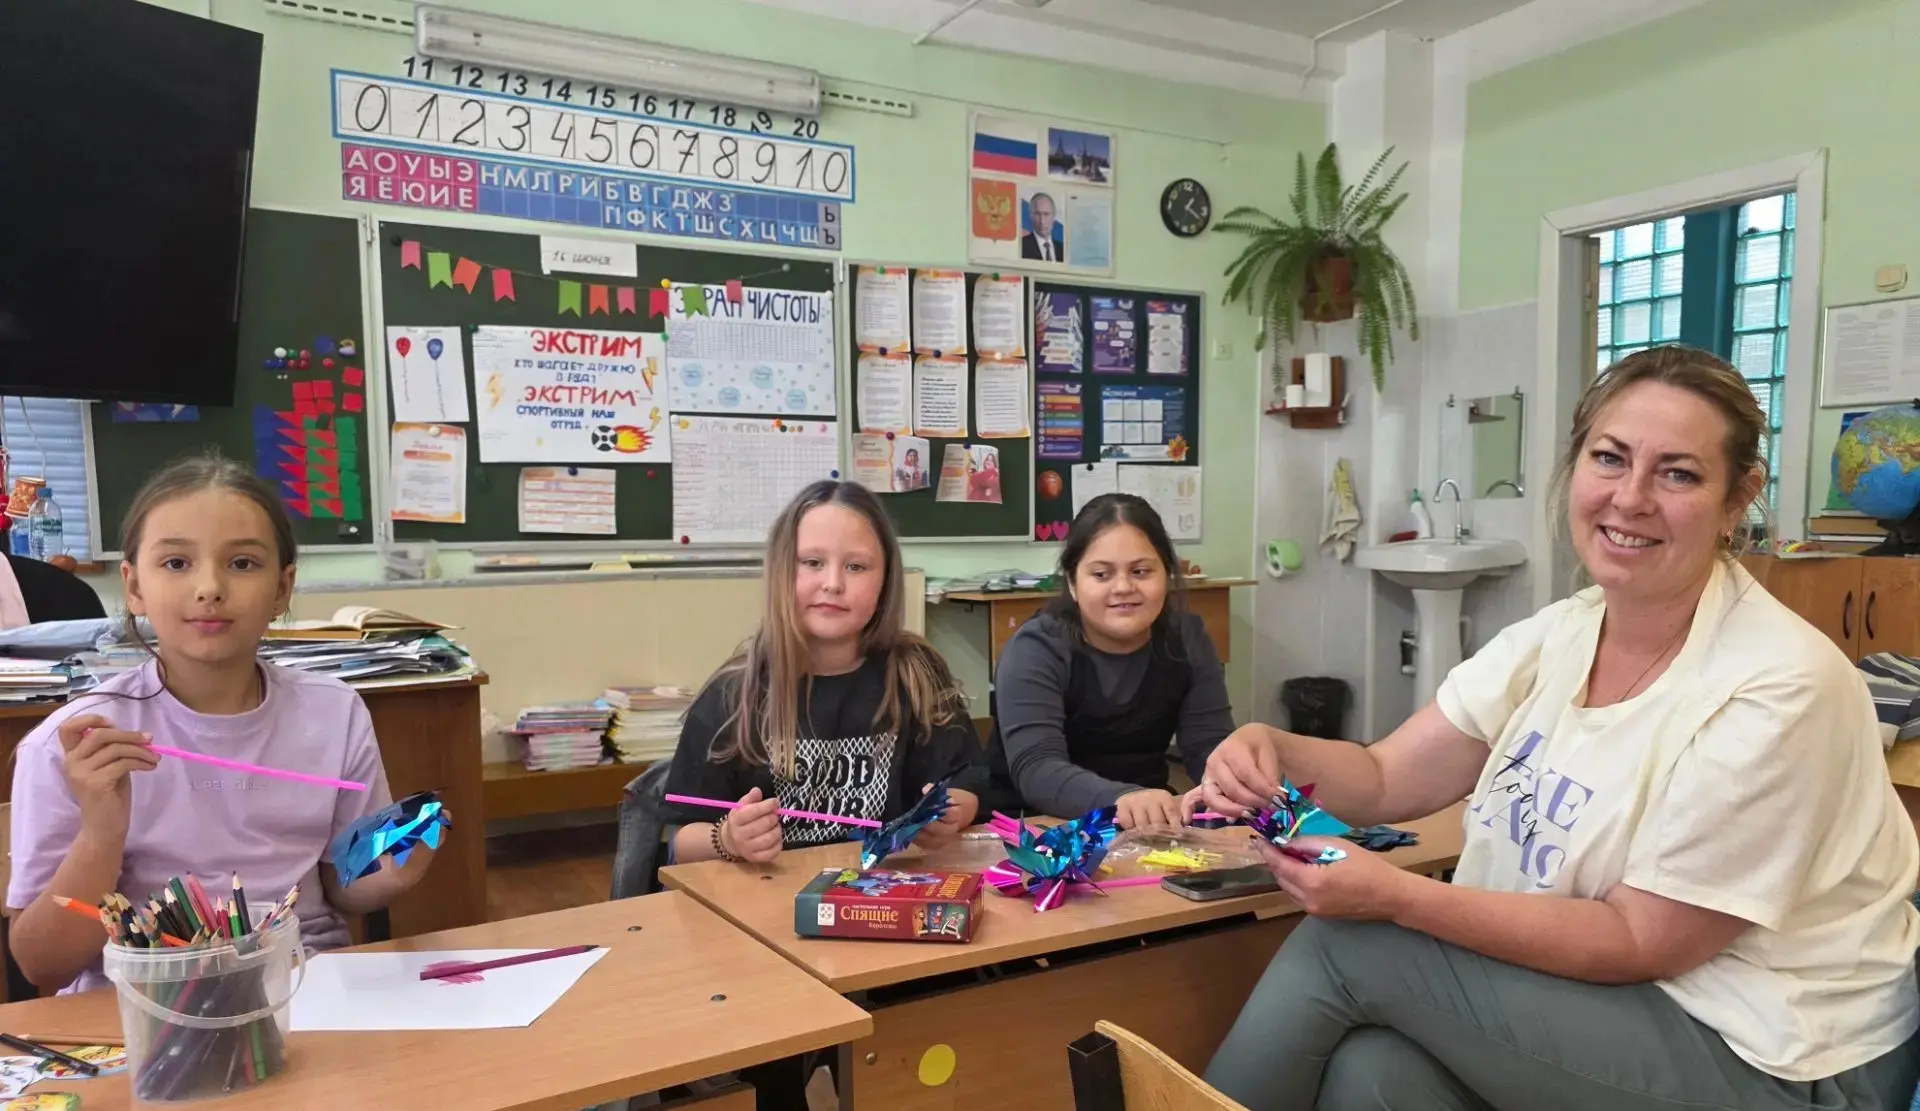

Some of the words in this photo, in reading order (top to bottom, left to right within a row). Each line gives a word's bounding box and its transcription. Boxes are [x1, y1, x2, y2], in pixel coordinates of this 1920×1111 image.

[403, 56, 435, 80] 11
[451, 64, 484, 88] 12
[497, 73, 528, 96] 13
[542, 79, 572, 102] 14
[586, 86, 616, 108] 15
[629, 93, 657, 115] 16
[668, 99, 695, 120] 17
[710, 105, 736, 126] 18
[793, 118, 819, 139] 20
[355, 84, 387, 132] 0
[416, 94, 438, 139] 1
[453, 99, 484, 145] 2
[498, 105, 530, 150] 3
[551, 112, 573, 157] 4
[585, 117, 618, 163] 5
[629, 124, 659, 168] 6
[673, 130, 700, 173] 7
[712, 136, 738, 179] 8
[751, 142, 776, 184] 9
[748, 290, 821, 324] ЧИСТОТЫ
[530, 329, 642, 359] ЭКСТРИМ
[524, 385, 636, 407] ЭКСТРИМ
[516, 405, 584, 418] СПОРТИВНЫЙ
[591, 409, 616, 419] НАШ
[840, 905, 899, 923] Спящие
